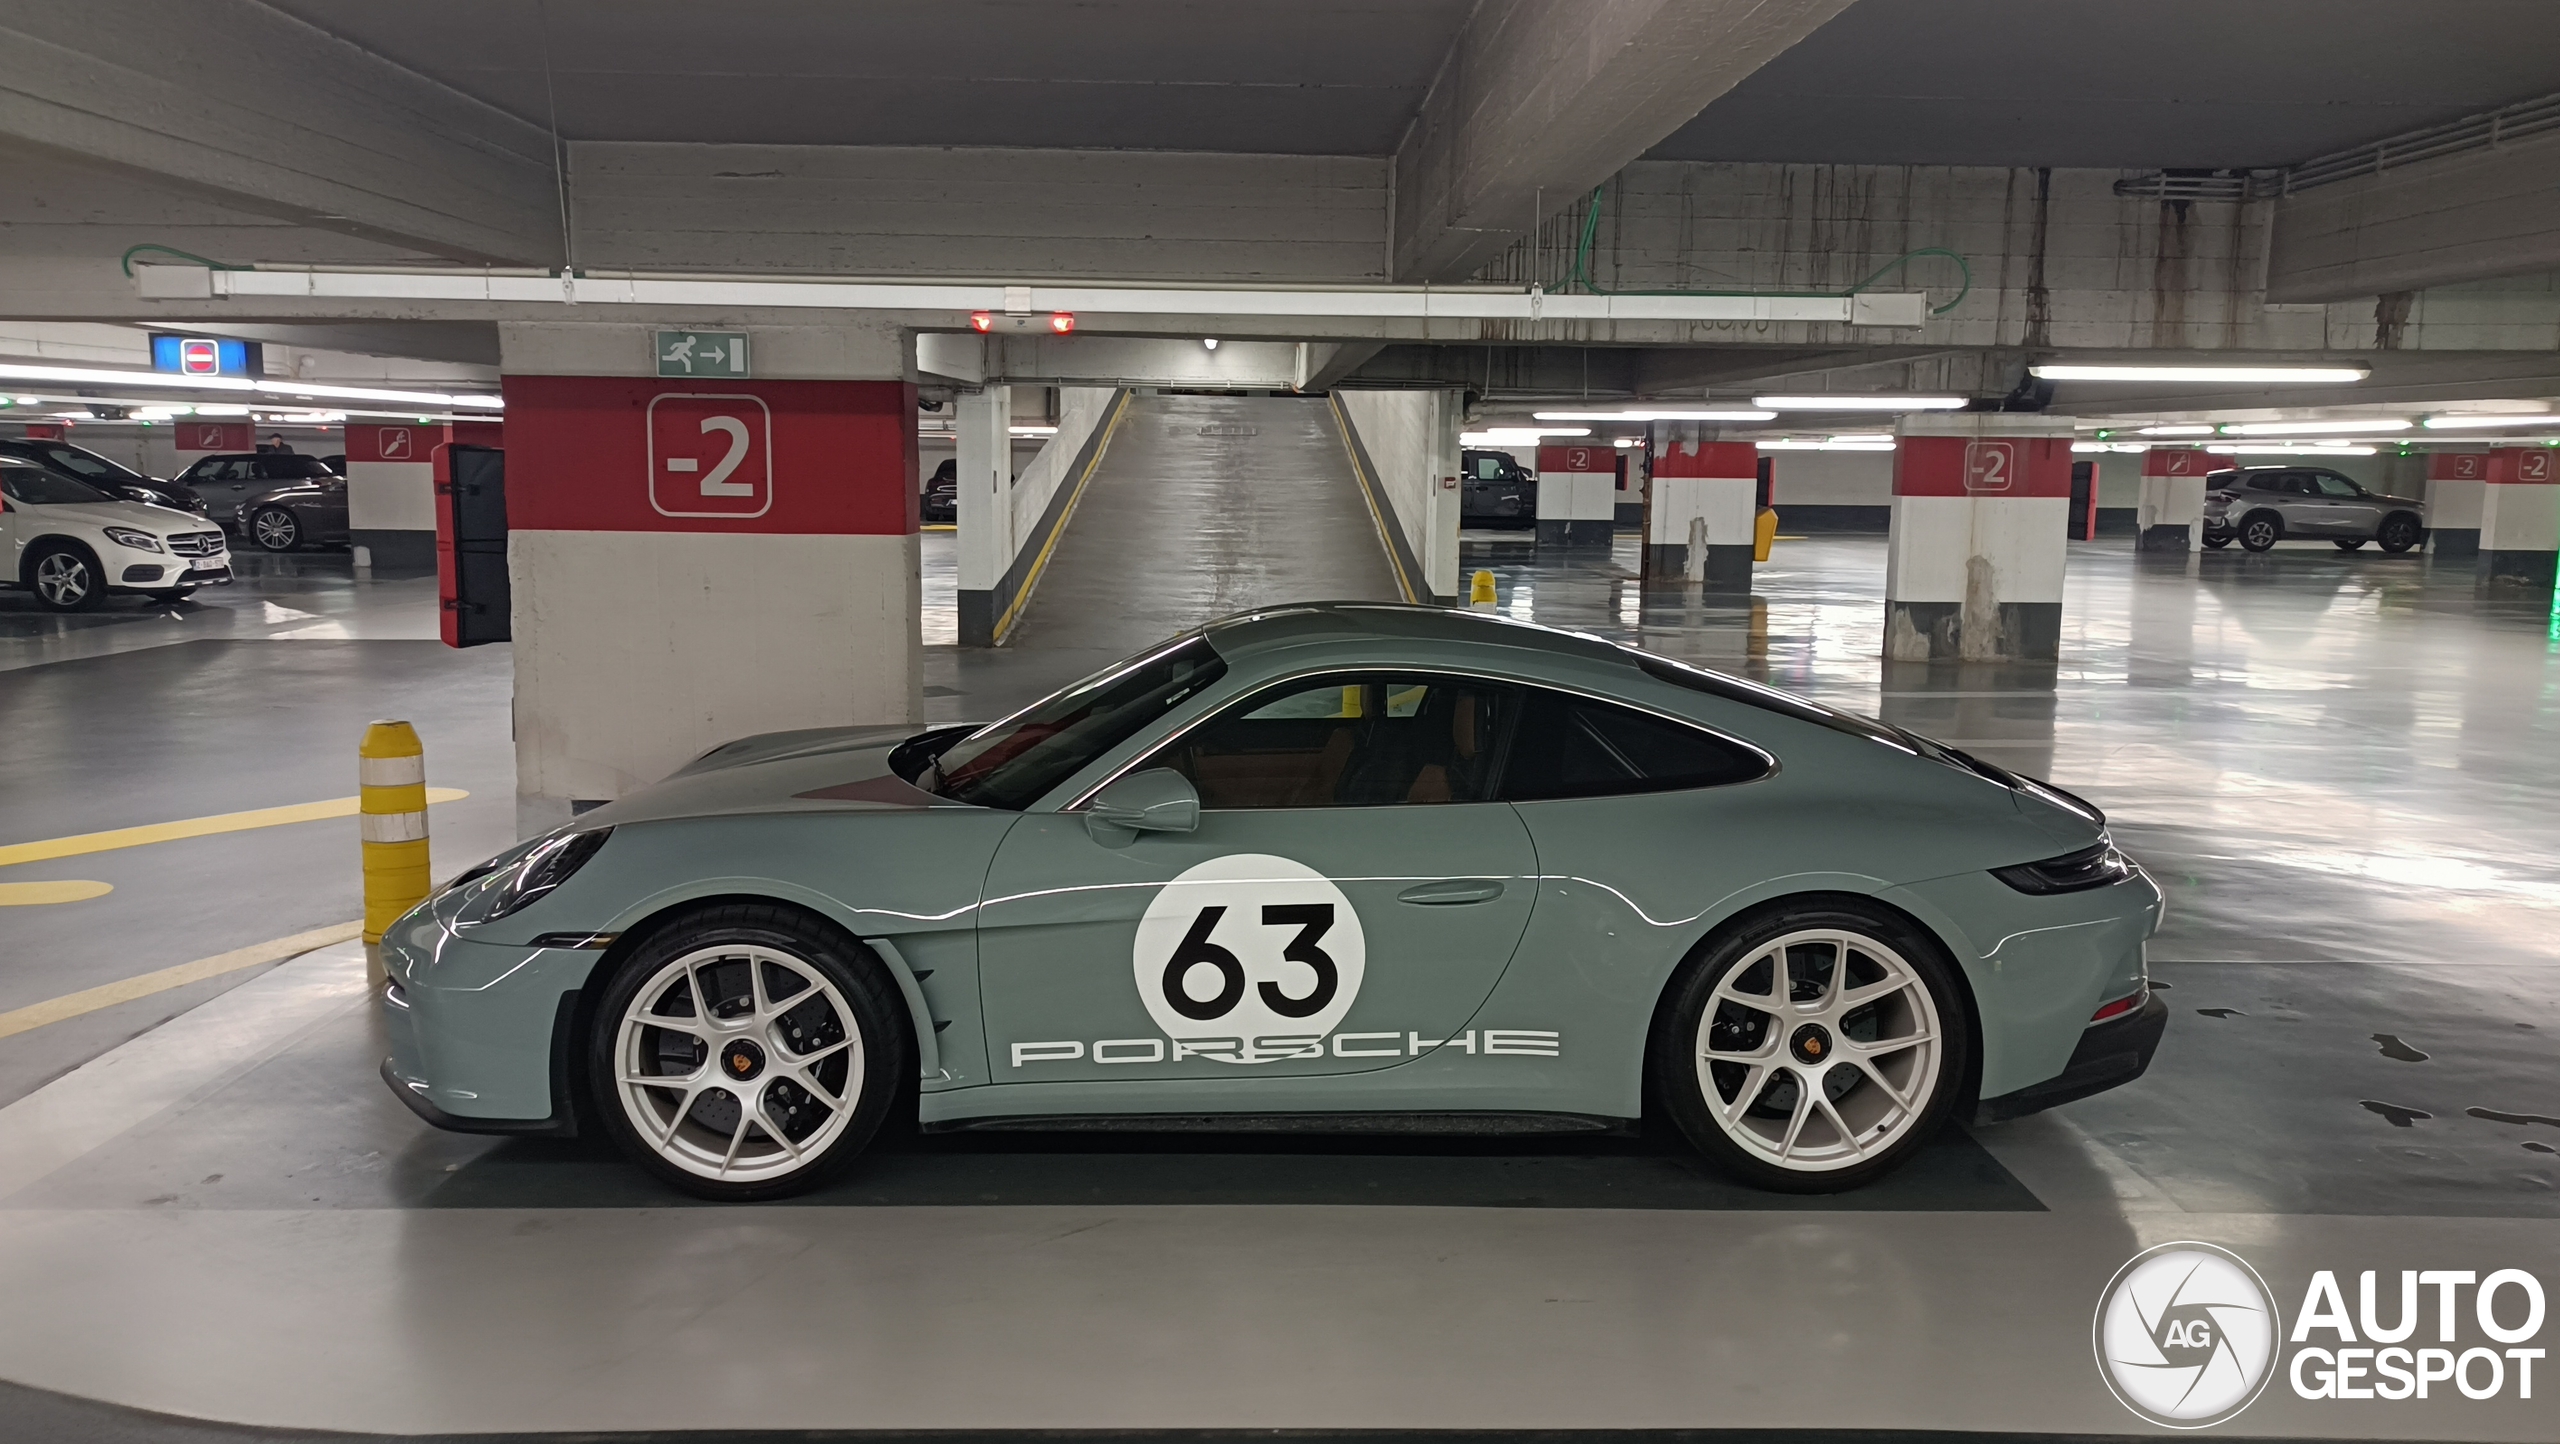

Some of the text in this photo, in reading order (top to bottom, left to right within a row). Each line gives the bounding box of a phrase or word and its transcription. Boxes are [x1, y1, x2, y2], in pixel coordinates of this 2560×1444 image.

[667, 415, 753, 497] -2
[1570, 451, 1586, 467] -2
[1971, 450, 2005, 483] -2
[2458, 459, 2474, 475] -2
[2523, 455, 2545, 476] -2
[1162, 903, 1338, 1021] 63
[1010, 1029, 1560, 1068] PORSCHE
